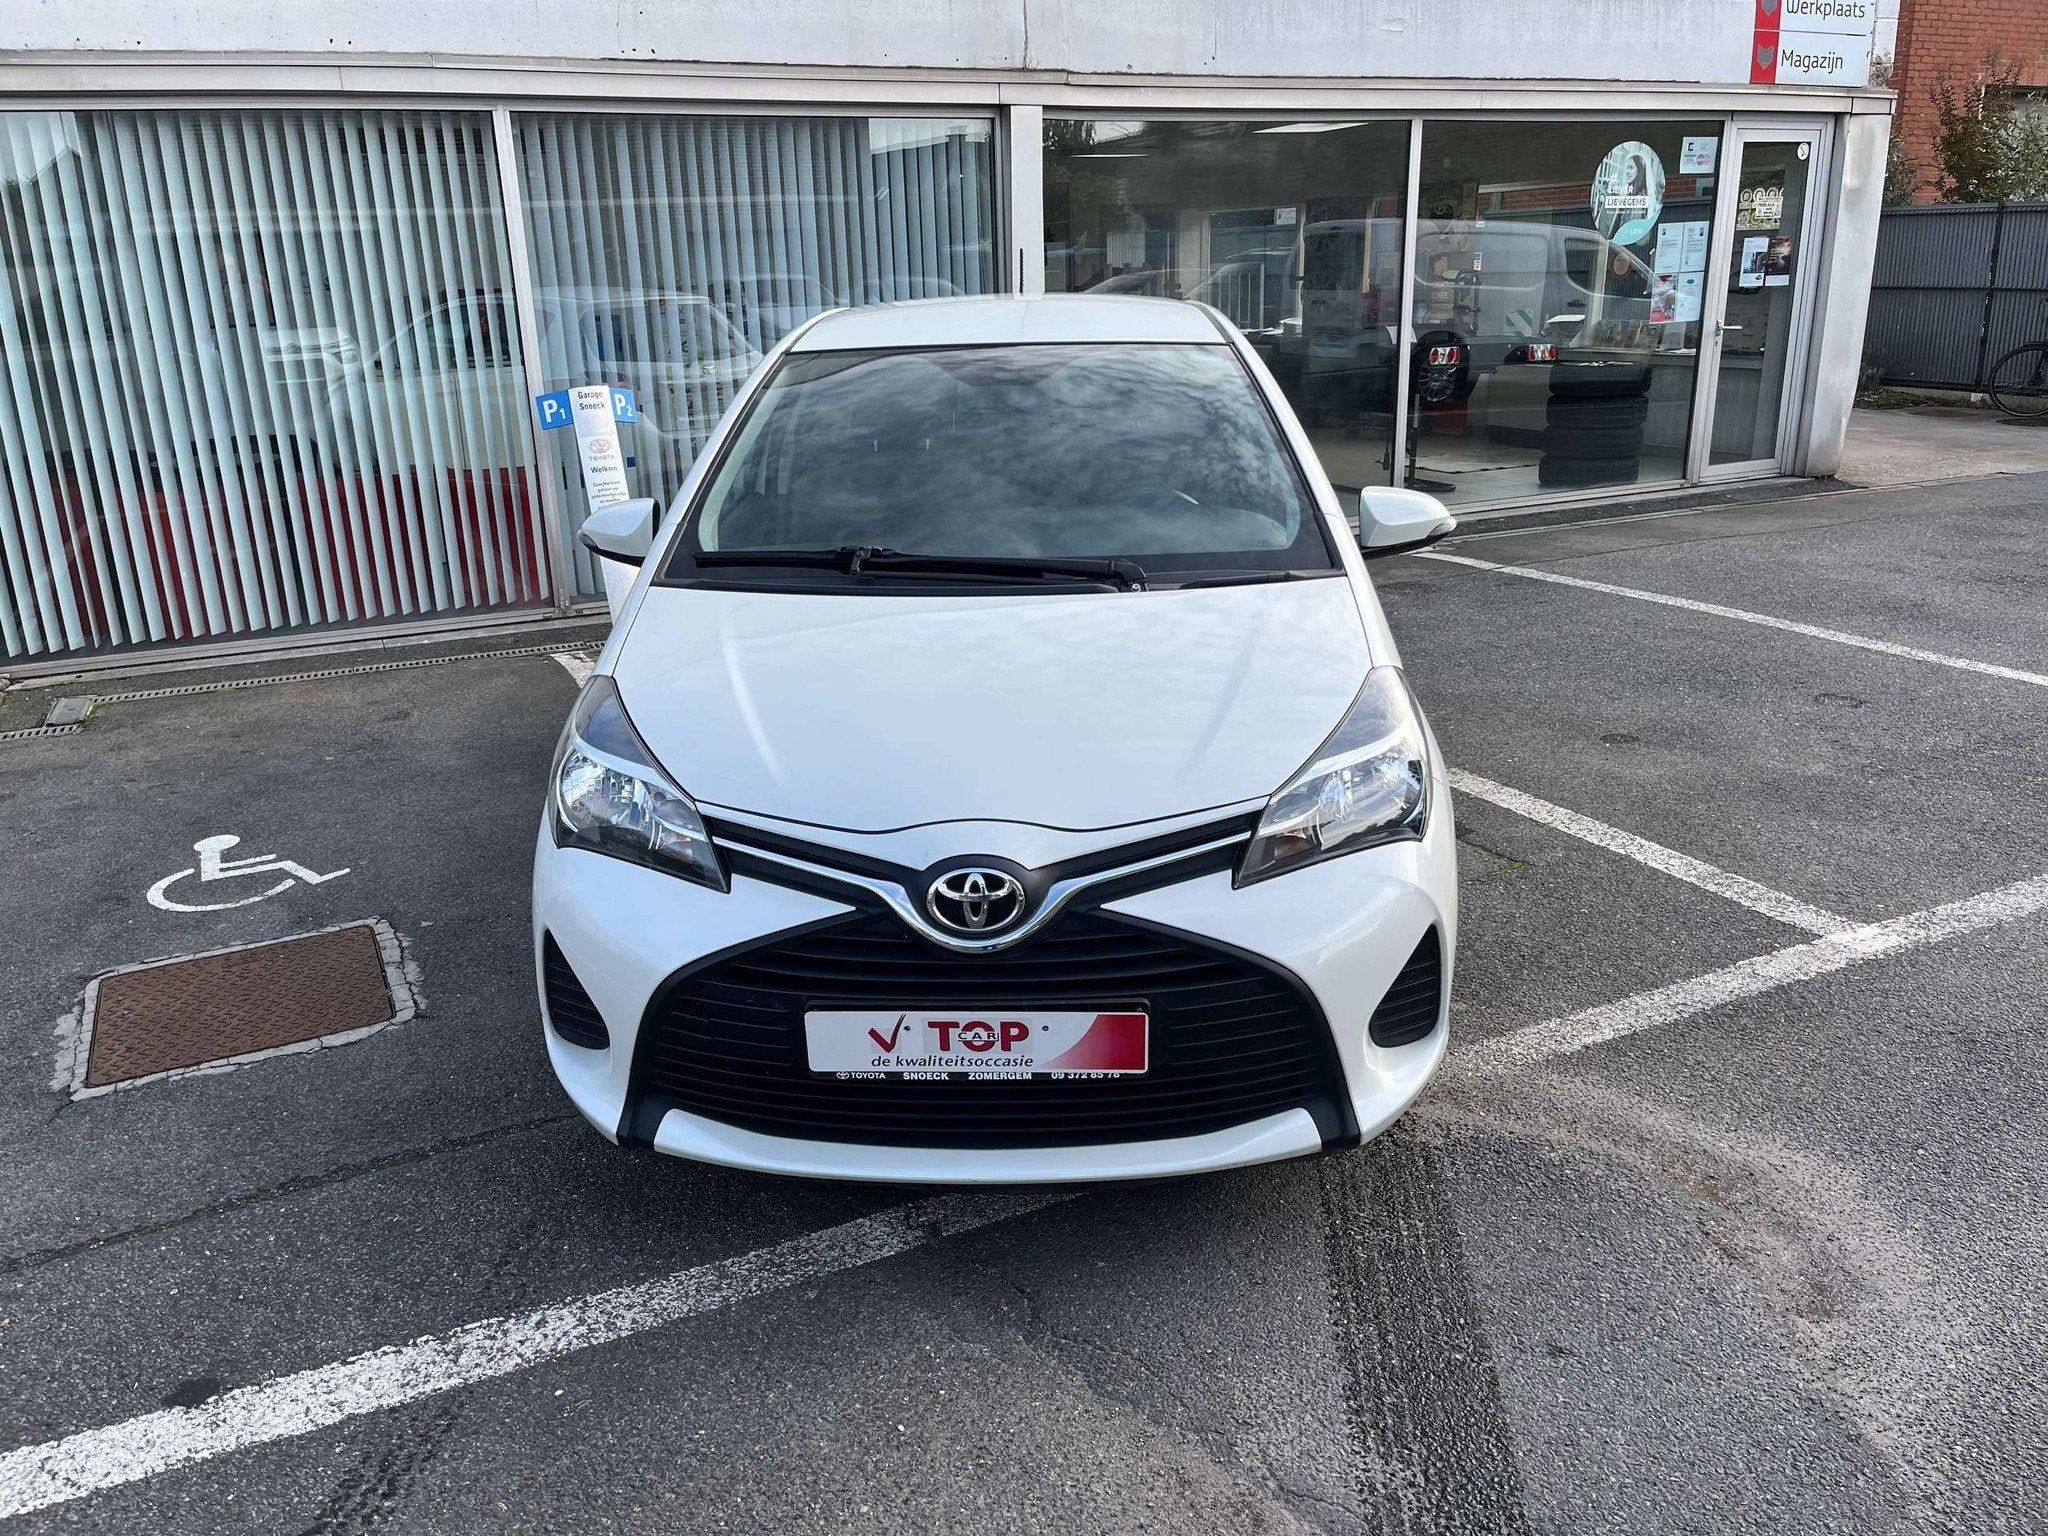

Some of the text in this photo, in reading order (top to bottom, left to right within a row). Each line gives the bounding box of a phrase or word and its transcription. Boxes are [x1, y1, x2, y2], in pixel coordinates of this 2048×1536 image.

[1786, 0, 1866, 20] Werkplaats
[1781, 49, 1844, 74] Magazijn
[1607, 198, 1647, 206] LIEVEGEMS
[577, 391, 603, 400] Garage
[579, 402, 605, 411] Snoeck
[589, 454, 615, 462] TOYOTA
[590, 465, 618, 473] Welkom
[927, 1020, 1030, 1053] TOP
[957, 1032, 998, 1041] CAR
[871, 1055, 1034, 1067] de kwaliteitsoccasie
[851, 1072, 886, 1080] TOYOTA
[902, 1072, 949, 1081] SNOECK
[968, 1072, 1032, 1081] ZOMERGEM
[1051, 1071, 1065, 1079] 09
